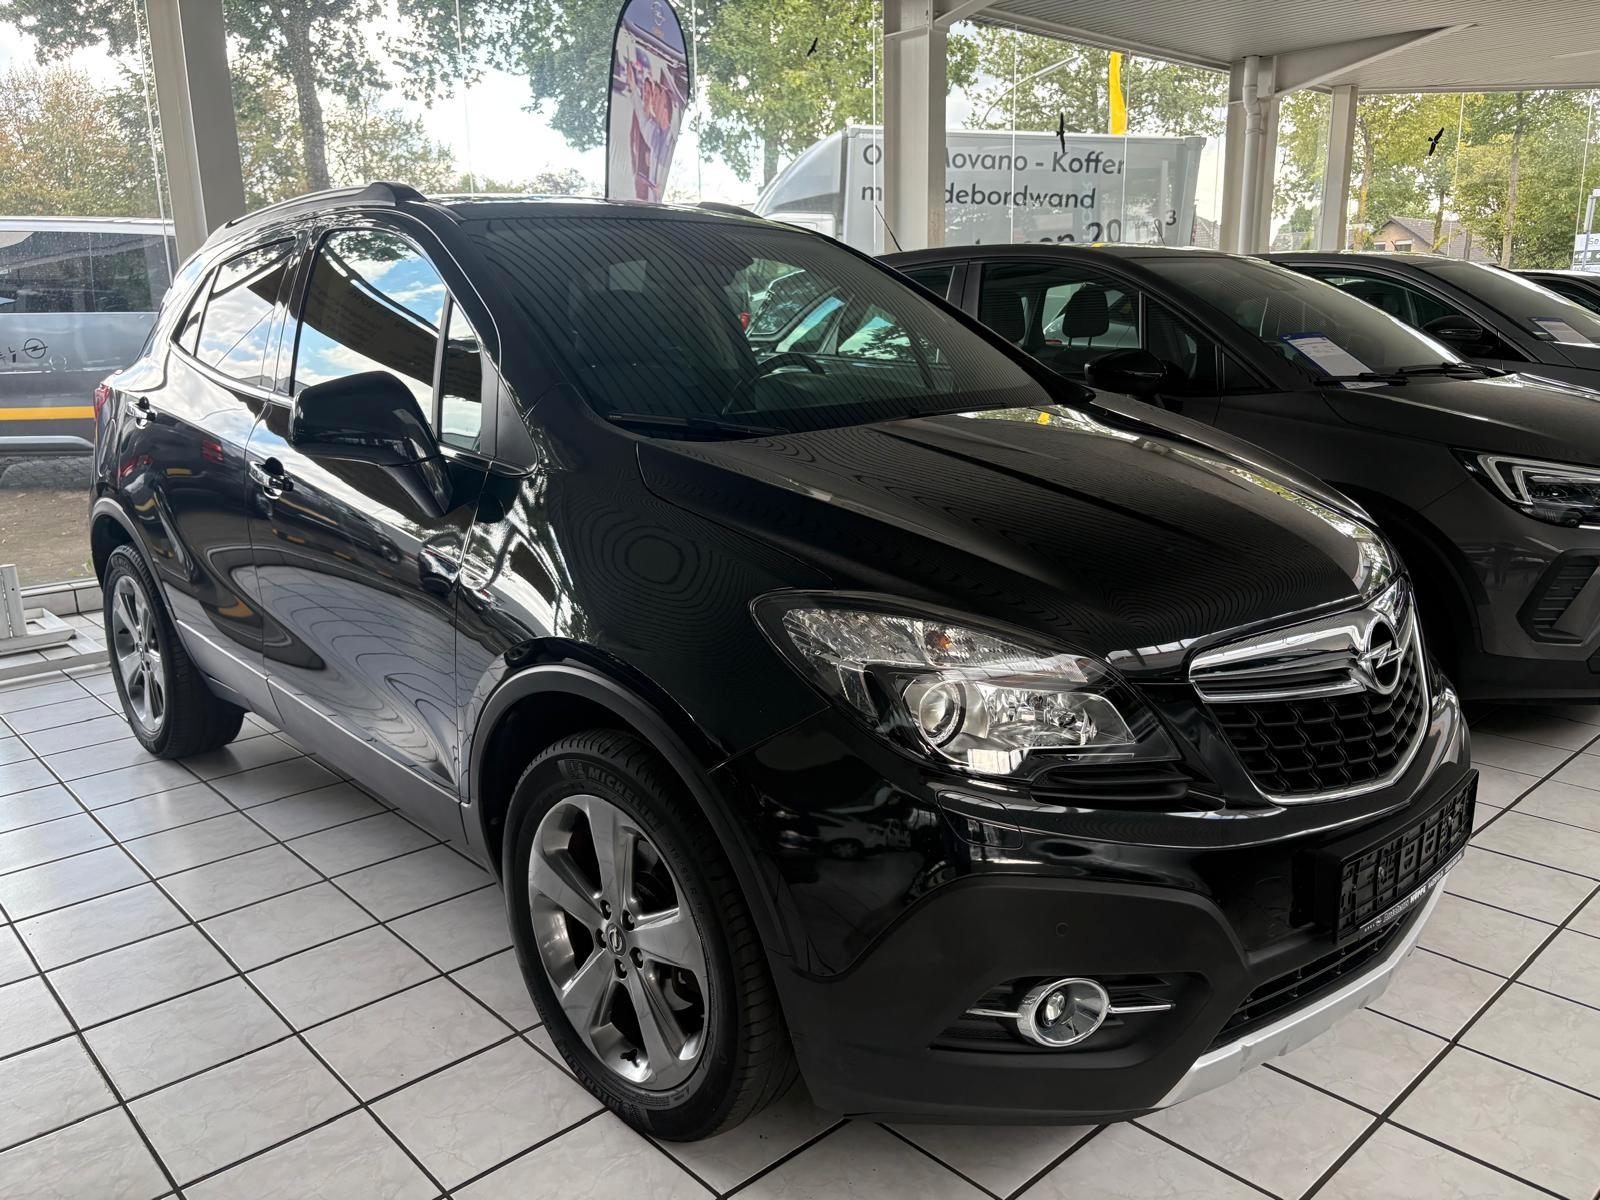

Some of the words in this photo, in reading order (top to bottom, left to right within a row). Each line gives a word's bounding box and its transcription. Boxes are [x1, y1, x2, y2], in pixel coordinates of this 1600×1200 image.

[1052, 150, 1125, 175] Koffer
[945, 182, 1096, 209] debordwand
[588, 766, 661, 829] MICHELIN
